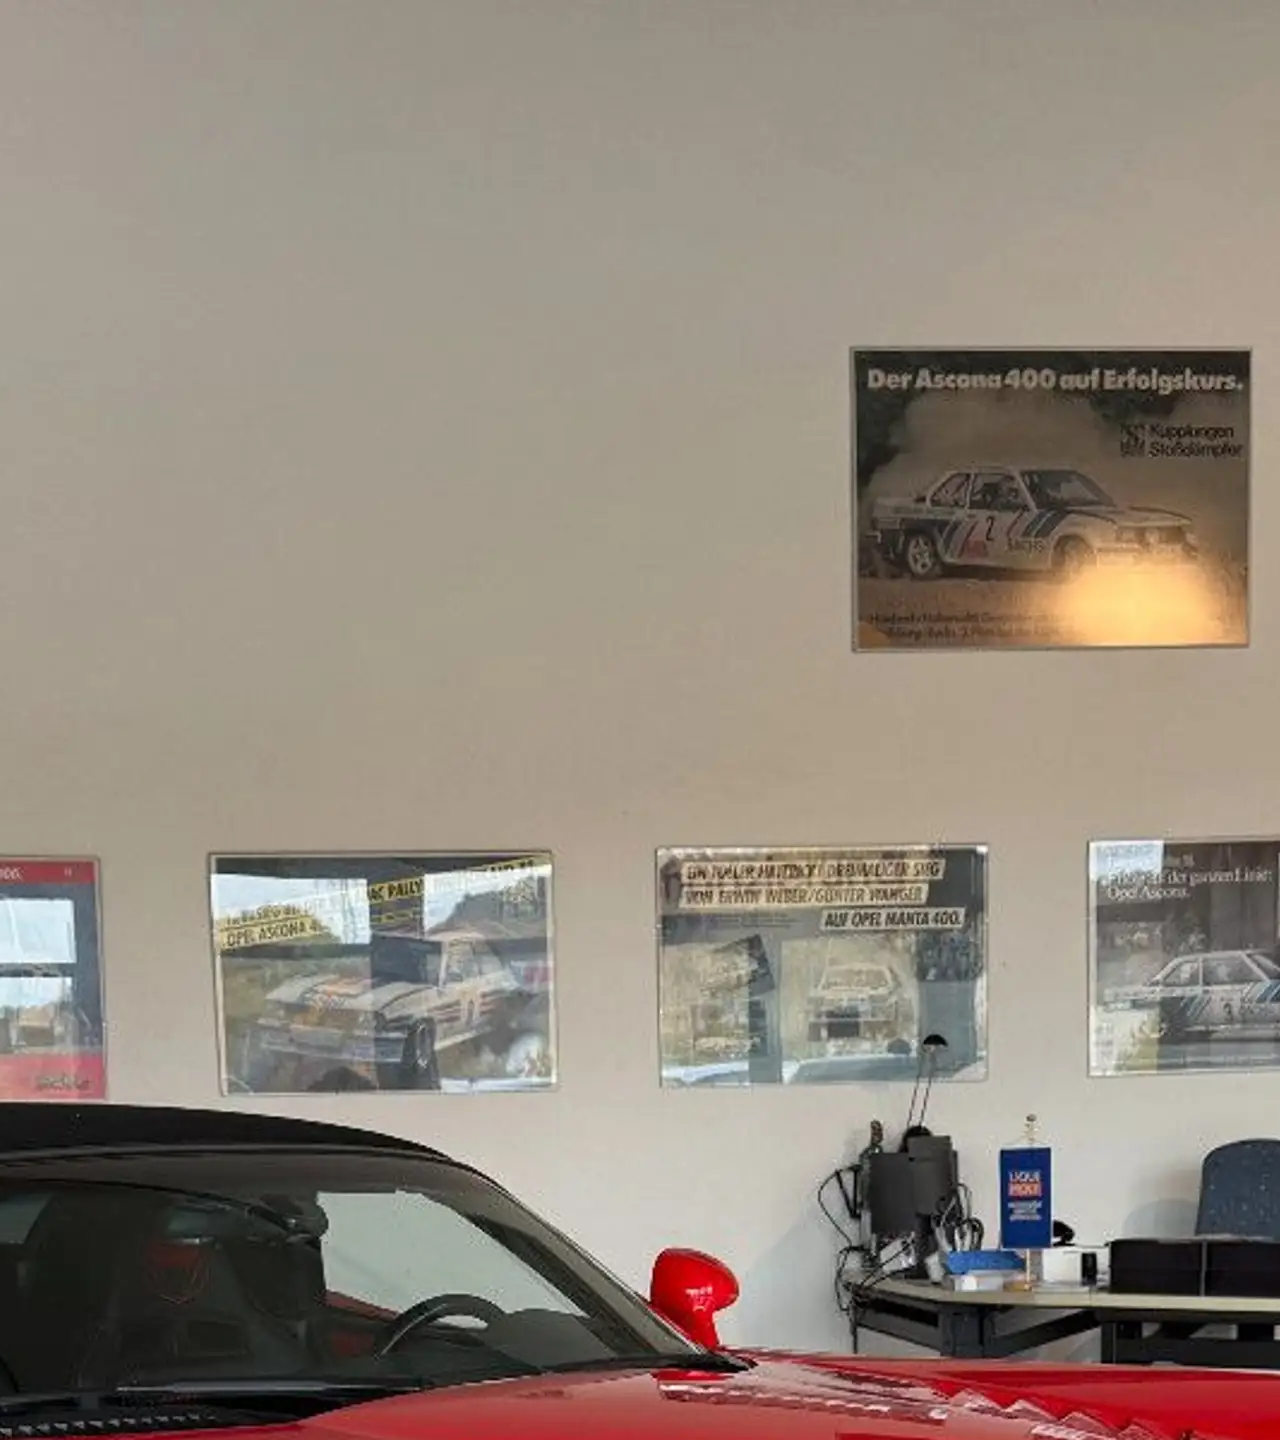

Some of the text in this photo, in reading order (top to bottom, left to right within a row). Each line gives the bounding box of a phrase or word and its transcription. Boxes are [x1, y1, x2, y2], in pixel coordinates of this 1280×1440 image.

[867, 368, 1244, 396] Der Ascona 400 auf Erfolgskurs.
